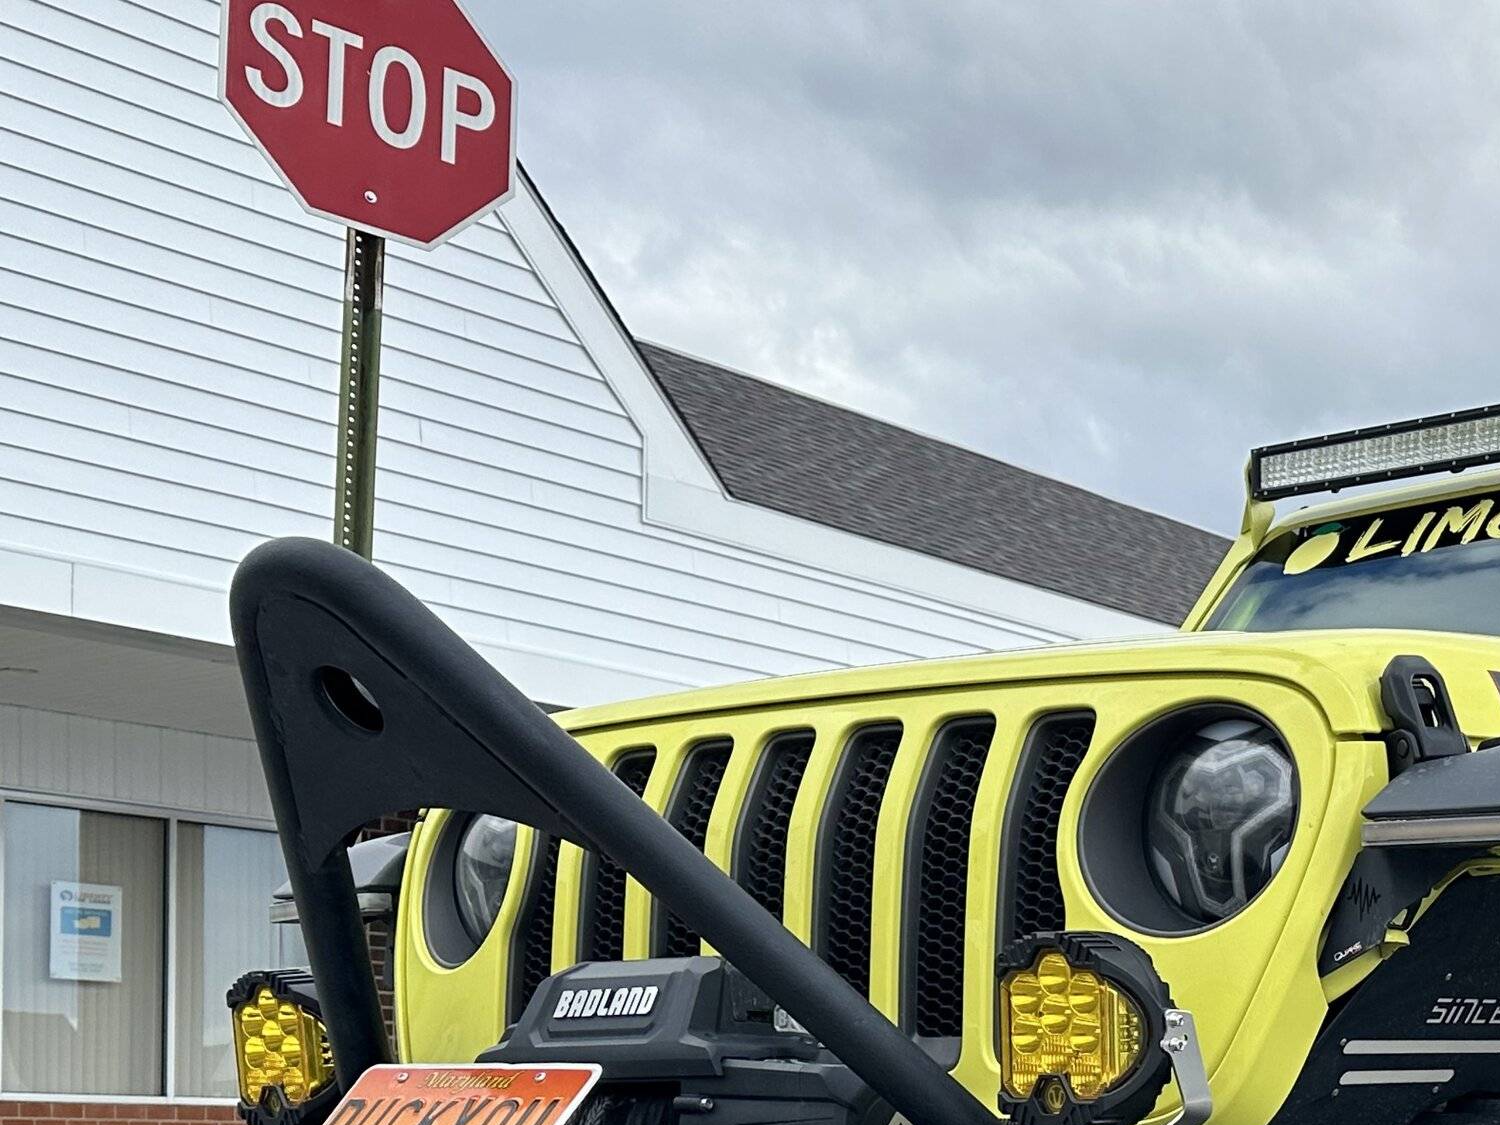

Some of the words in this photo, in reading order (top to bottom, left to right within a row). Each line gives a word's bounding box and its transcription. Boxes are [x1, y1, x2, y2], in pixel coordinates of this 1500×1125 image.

[244, 2, 496, 165] STOP
[553, 986, 659, 1018] BADLAND
[418, 1070, 520, 1095] Maryland
